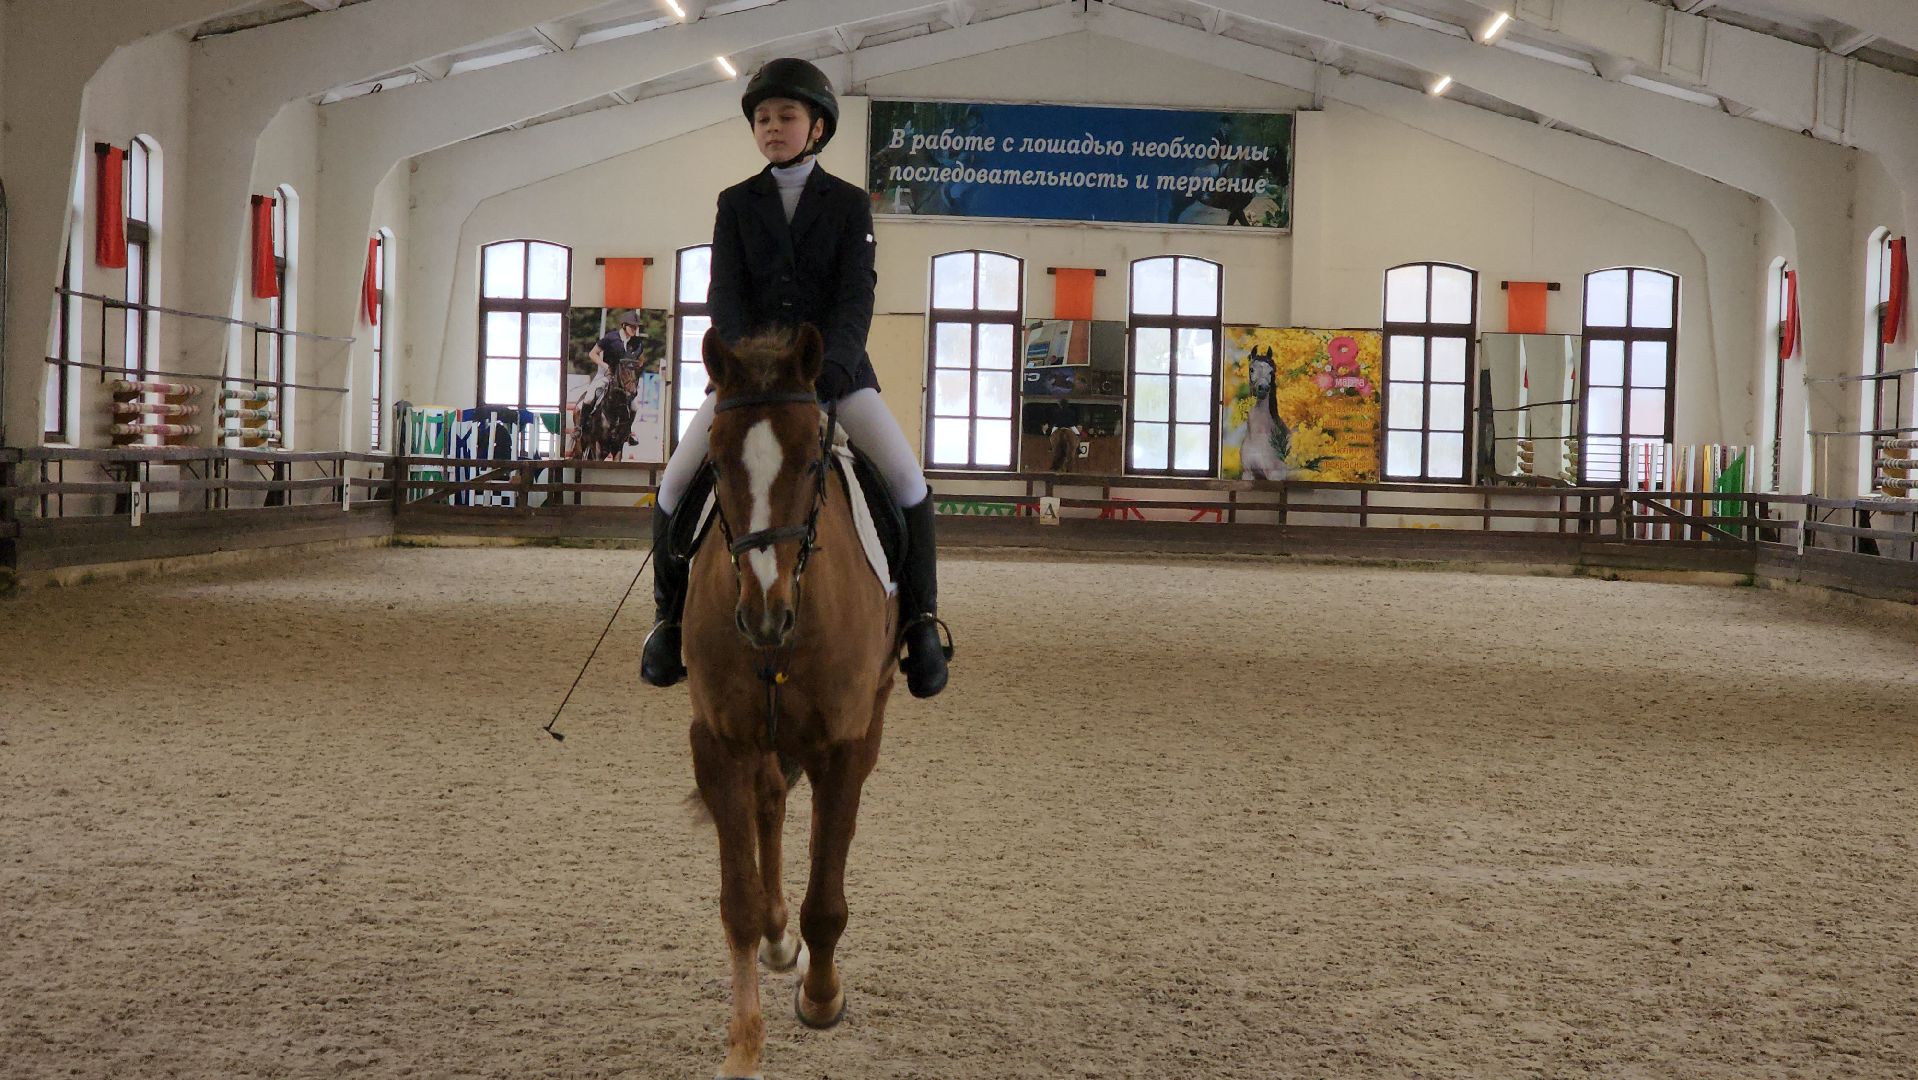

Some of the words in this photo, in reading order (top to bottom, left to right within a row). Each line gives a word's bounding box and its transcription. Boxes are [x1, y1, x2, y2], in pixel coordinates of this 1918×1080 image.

[889, 129, 905, 149] В
[909, 128, 995, 154] работе
[1002, 137, 1015, 152] с
[1019, 133, 1124, 157] лошадью
[1131, 136, 1270, 162] необходимы
[889, 160, 1129, 189] последовательность
[1135, 177, 1149, 189] и
[1156, 176, 1266, 197] терпение
[133, 492, 140, 517] P
[1045, 503, 1057, 519] A
